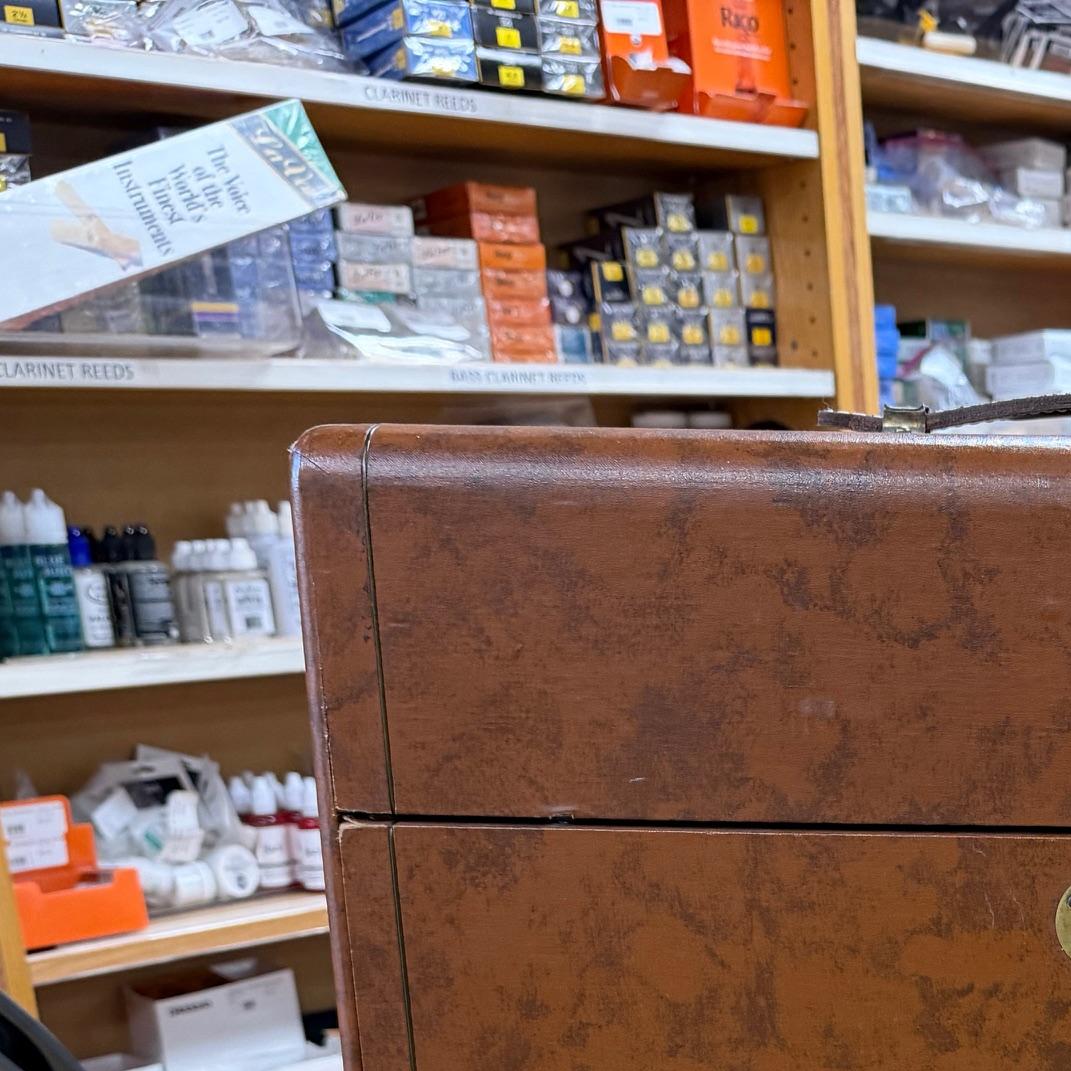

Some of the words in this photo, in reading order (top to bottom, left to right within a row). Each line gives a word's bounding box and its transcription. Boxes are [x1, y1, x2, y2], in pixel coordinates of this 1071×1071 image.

[364, 85, 430, 107] CLARINET
[433, 94, 478, 113] REEDS
[167, 162, 208, 224] World's
[192, 165, 211, 184] of
[207, 144, 232, 176] The
[224, 173, 252, 215] Voice
[112, 159, 176, 257] Instruments
[148, 176, 187, 226] Finest
[200, 180, 226, 209] the
[81, 362, 135, 381] REEDS
